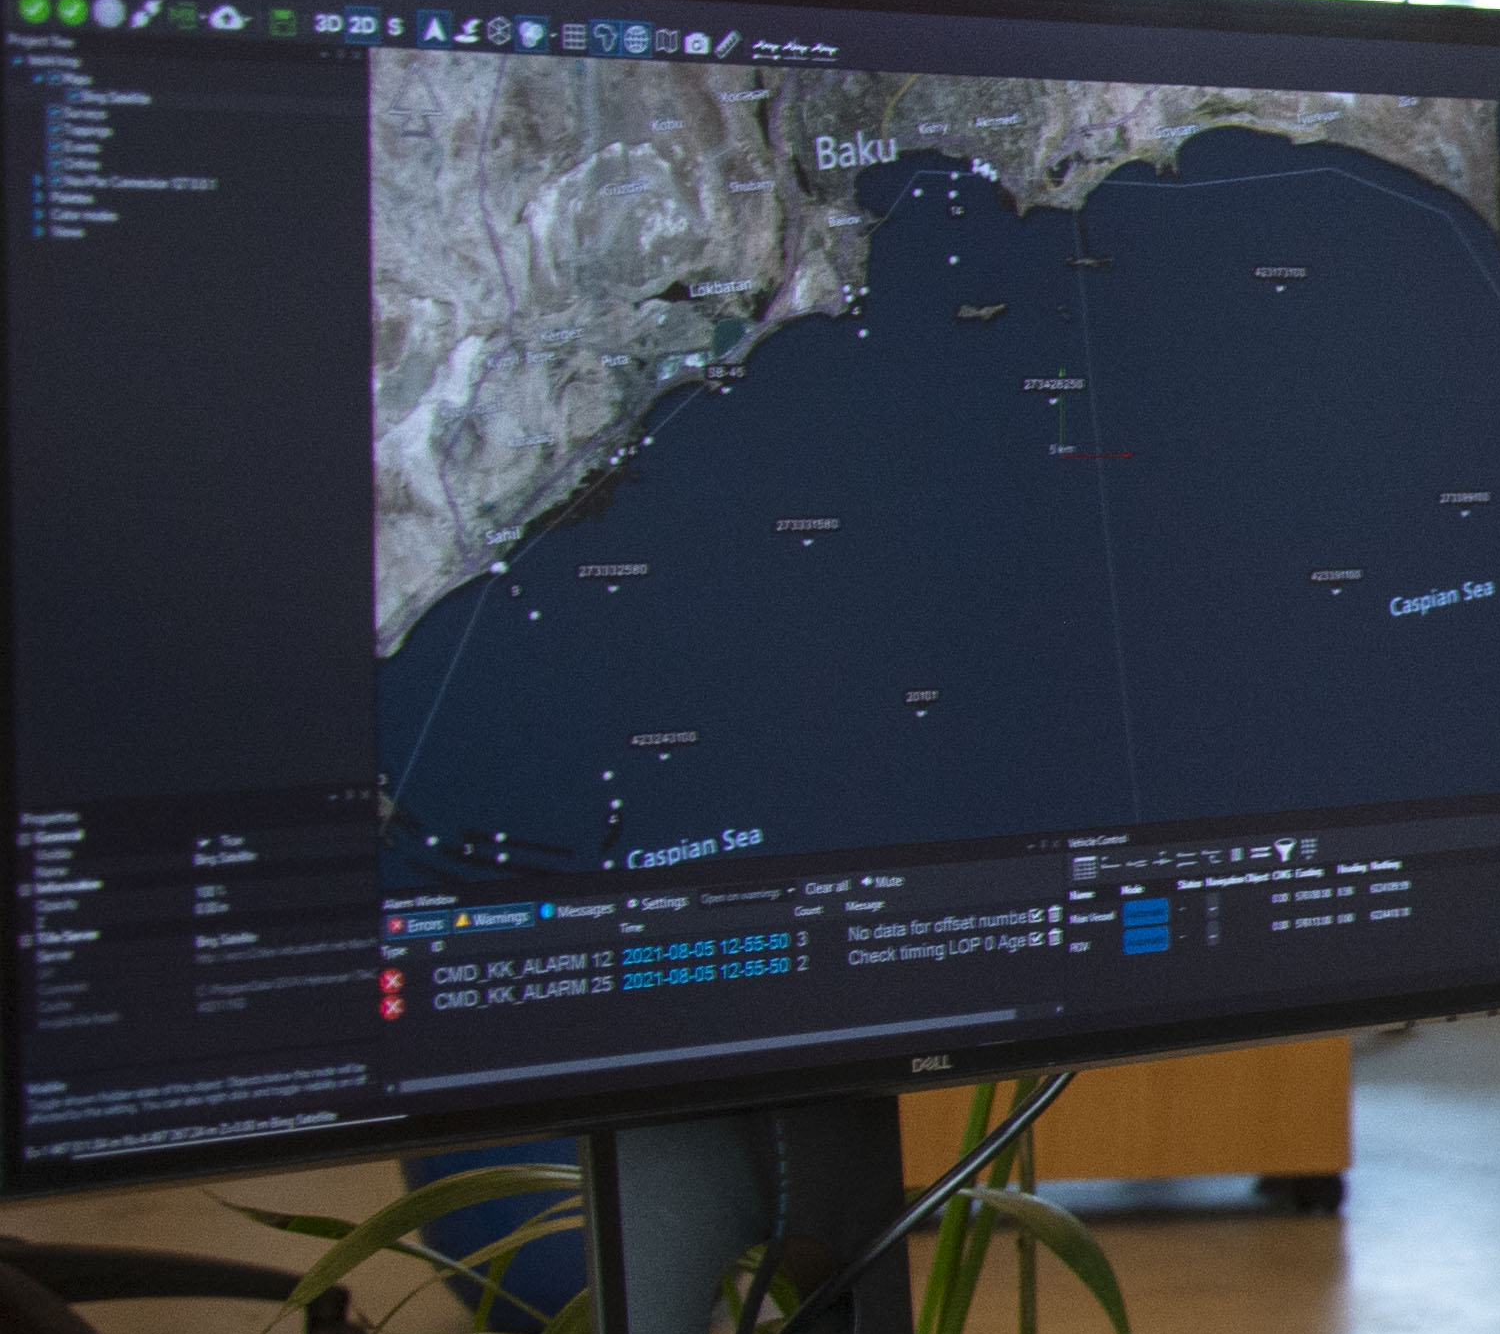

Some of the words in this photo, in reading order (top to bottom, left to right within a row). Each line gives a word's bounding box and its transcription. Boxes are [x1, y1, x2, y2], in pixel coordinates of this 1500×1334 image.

[315, 12, 344, 33] 3D
[350, 14, 377, 34] 2D
[387, 17, 402, 36] S
[815, 131, 898, 171] Baku
[1389, 586, 1460, 617] Caspian
[1462, 580, 1495, 601] Sea
[626, 833, 718, 870] Caspian
[721, 827, 764, 851] Sea
[805, 880, 833, 896] Clear
[835, 878, 850, 893] all
[875, 875, 904, 889] Mute
[556, 902, 616, 921] Messages
[641, 895, 691, 913] Settings
[407, 916, 446, 934] Errors
[474, 908, 531, 929] Warnings
[433, 953, 589, 986] CMD_KK_ALARM
[592, 950, 615, 969] 12
[622, 941, 717, 967] 2021-08-05
[719, 931, 790, 958] 12-55-50
[797, 931, 809, 948] 3
[848, 924, 872, 943] No
[873, 921, 908, 940] data
[910, 918, 932, 936] for
[933, 914, 976, 934] offset
[433, 978, 589, 1012] CMD_KK_ALARM
[590, 975, 616, 994] 25
[622, 965, 717, 991] 2021-08-05
[719, 956, 790, 981] 12-55-50
[797, 954, 810, 972] 2
[848, 945, 897, 967] Check
[900, 940, 947, 964] timing
[949, 935, 982, 957] LOP
[984, 934, 996, 952] 0
[998, 931, 1028, 955] Age
[911, 1054, 953, 1075] DELL
